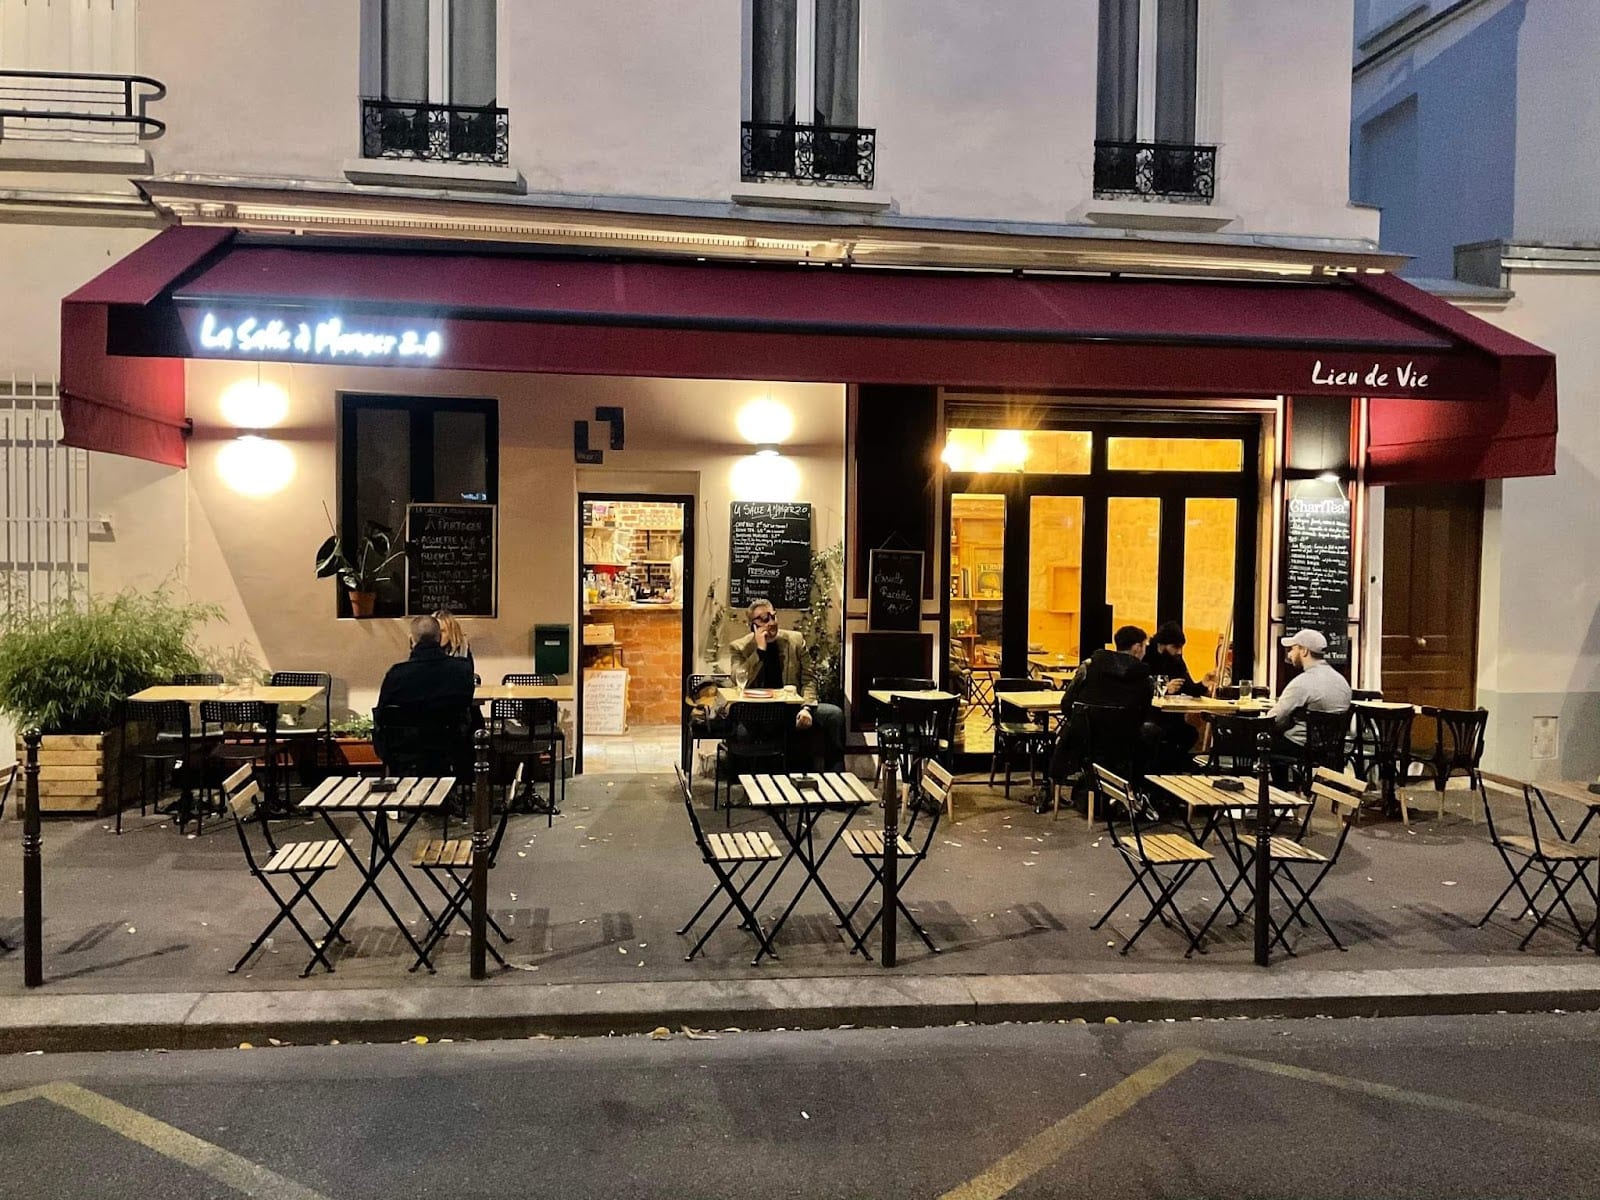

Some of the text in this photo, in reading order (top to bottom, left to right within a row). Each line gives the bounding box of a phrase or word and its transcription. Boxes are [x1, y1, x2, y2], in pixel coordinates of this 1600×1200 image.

[201, 313, 233, 350] La
[1311, 360, 1428, 387] Lieu de Vie
